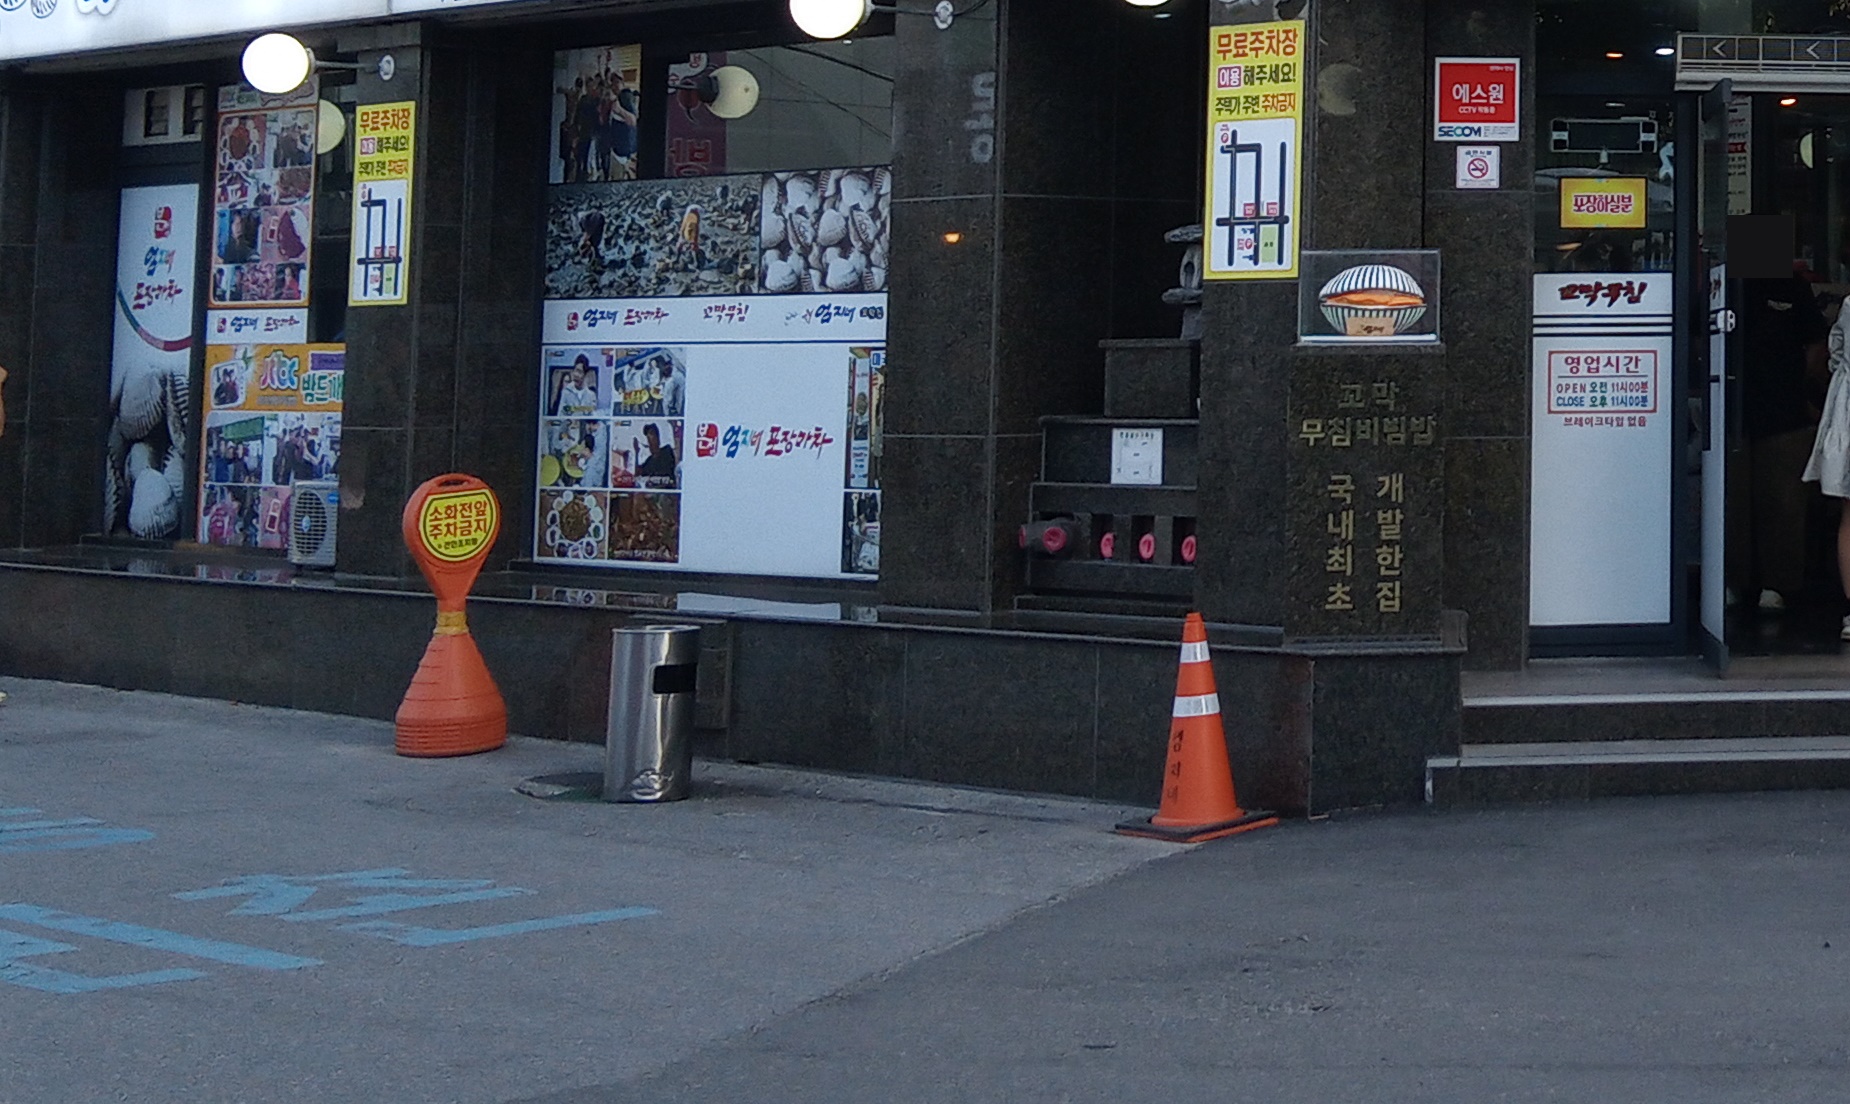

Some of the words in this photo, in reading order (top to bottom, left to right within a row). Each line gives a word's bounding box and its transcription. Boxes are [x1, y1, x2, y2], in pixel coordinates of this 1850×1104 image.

[1217, 28, 1298, 61] 무료주차장
[1219, 68, 1240, 87] 이용
[1242, 95, 1260, 114] 주변
[1262, 92, 1296, 113] 주차금지
[1452, 83, 1504, 104] 에스원
[360, 108, 411, 133] 무료주차장
[1438, 126, 1482, 137] SECOM
[1572, 193, 1635, 214] 포장하실분
[1564, 355, 1641, 374] 영업시간
[1338, 382, 1400, 410] 꼬막
[1556, 383, 1587, 394] OPEN
[1589, 381, 1608, 394] 오전
[1556, 396, 1585, 407] CLOSE
[1589, 395, 1608, 408] 오후
[1299, 417, 1439, 447] 무침비빔밥
[429, 500, 488, 522] 소화전앞
[429, 517, 488, 540] 주차금지
